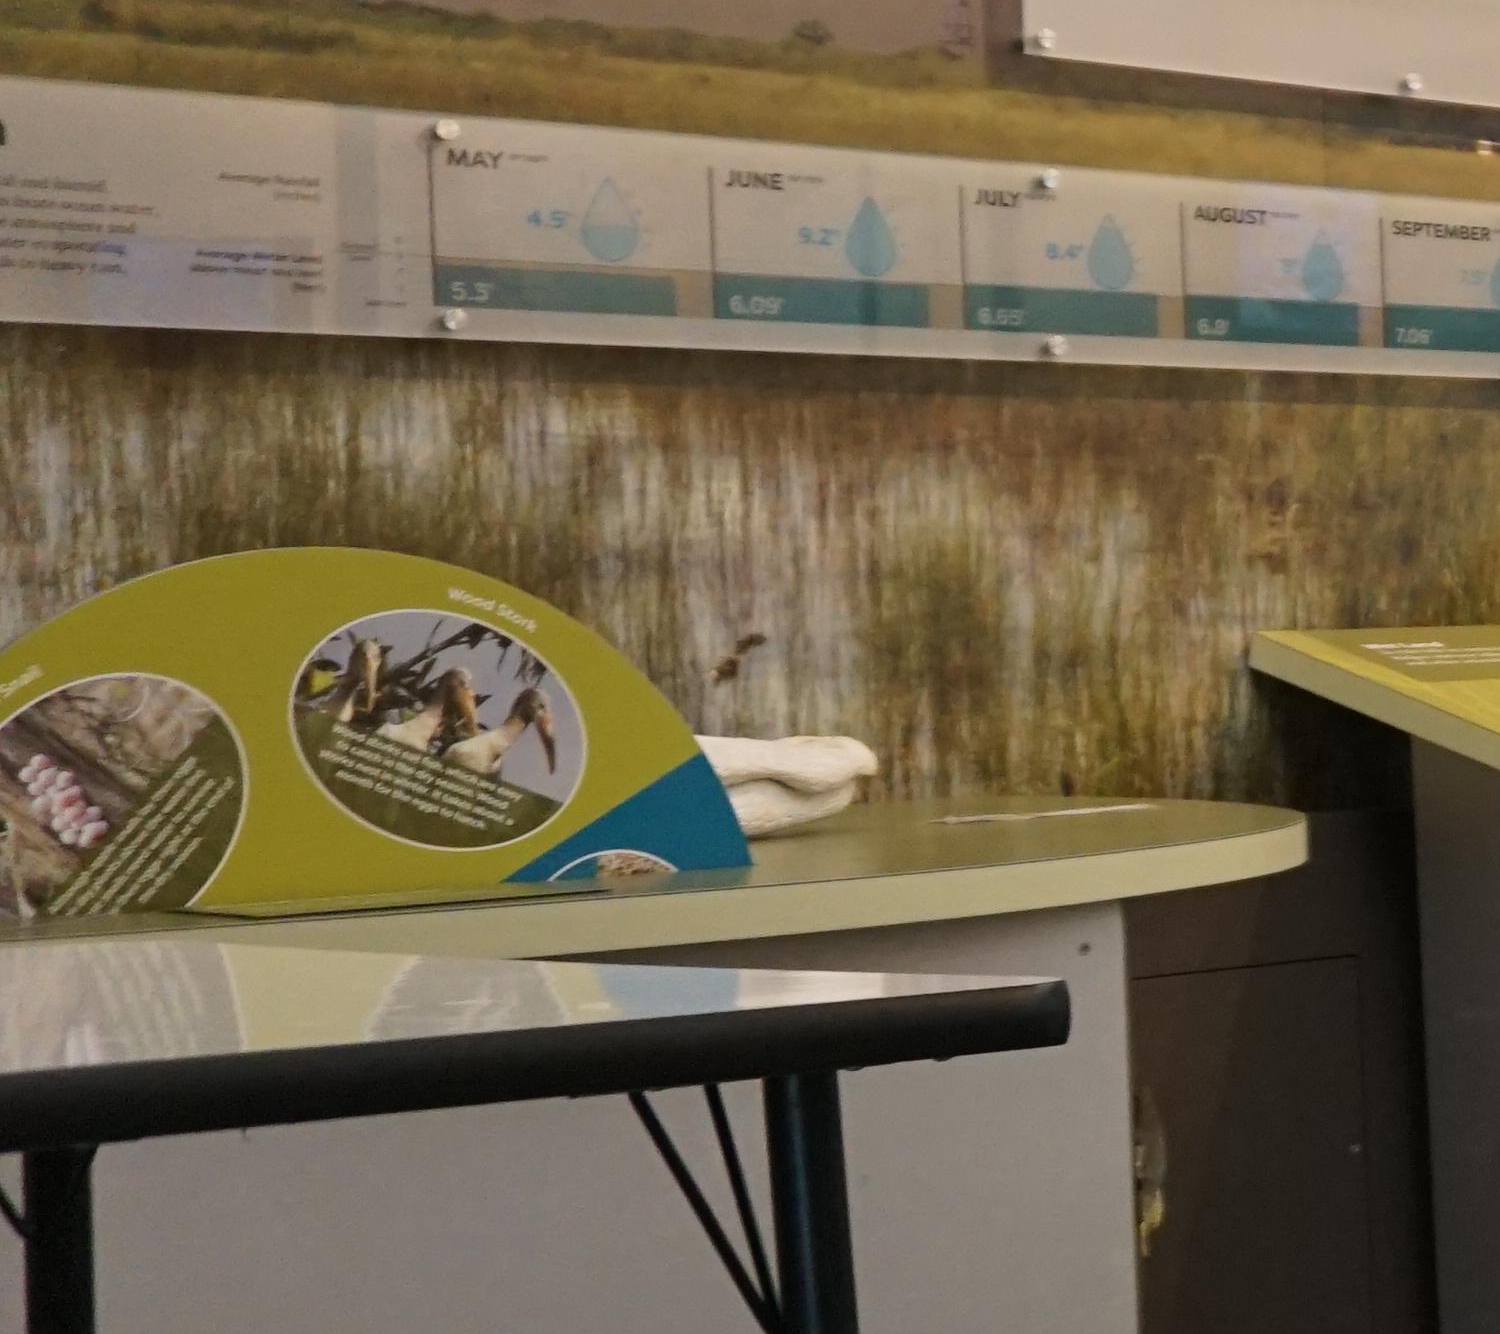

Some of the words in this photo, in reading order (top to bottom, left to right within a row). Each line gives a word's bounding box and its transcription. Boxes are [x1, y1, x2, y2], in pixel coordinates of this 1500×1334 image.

[446, 147, 504, 168] MAY
[725, 170, 786, 191] JUNE
[974, 188, 1022, 208] JULY
[1194, 205, 1268, 225] AUGUST
[1391, 220, 1492, 242] SEPTEMBER
[447, 587, 496, 612] Wood
[497, 602, 537, 633] Stork
